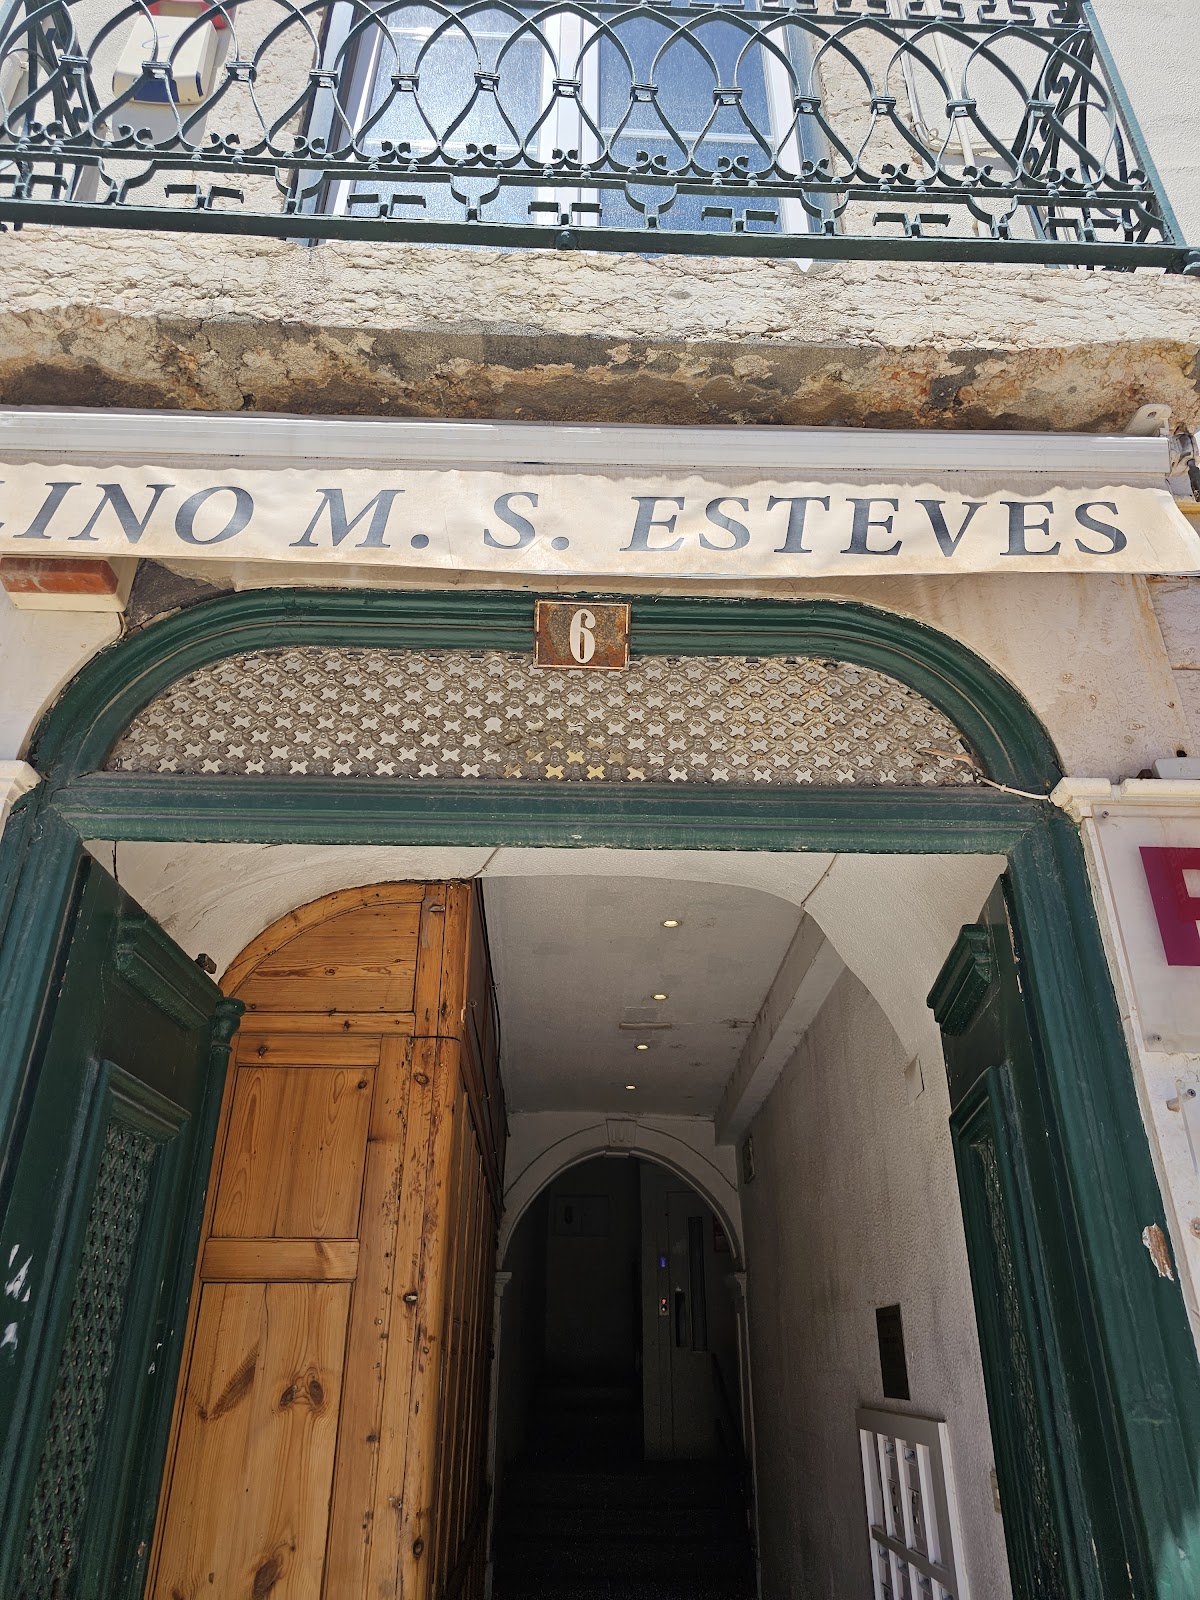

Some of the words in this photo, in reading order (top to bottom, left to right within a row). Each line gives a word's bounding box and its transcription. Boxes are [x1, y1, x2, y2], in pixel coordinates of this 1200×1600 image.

[0, 480, 255, 546] INO
[289, 488, 430, 549] M.
[483, 491, 570, 551] S.
[619, 494, 1128, 557] ESTEVES
[569, 608, 596, 664] 6
